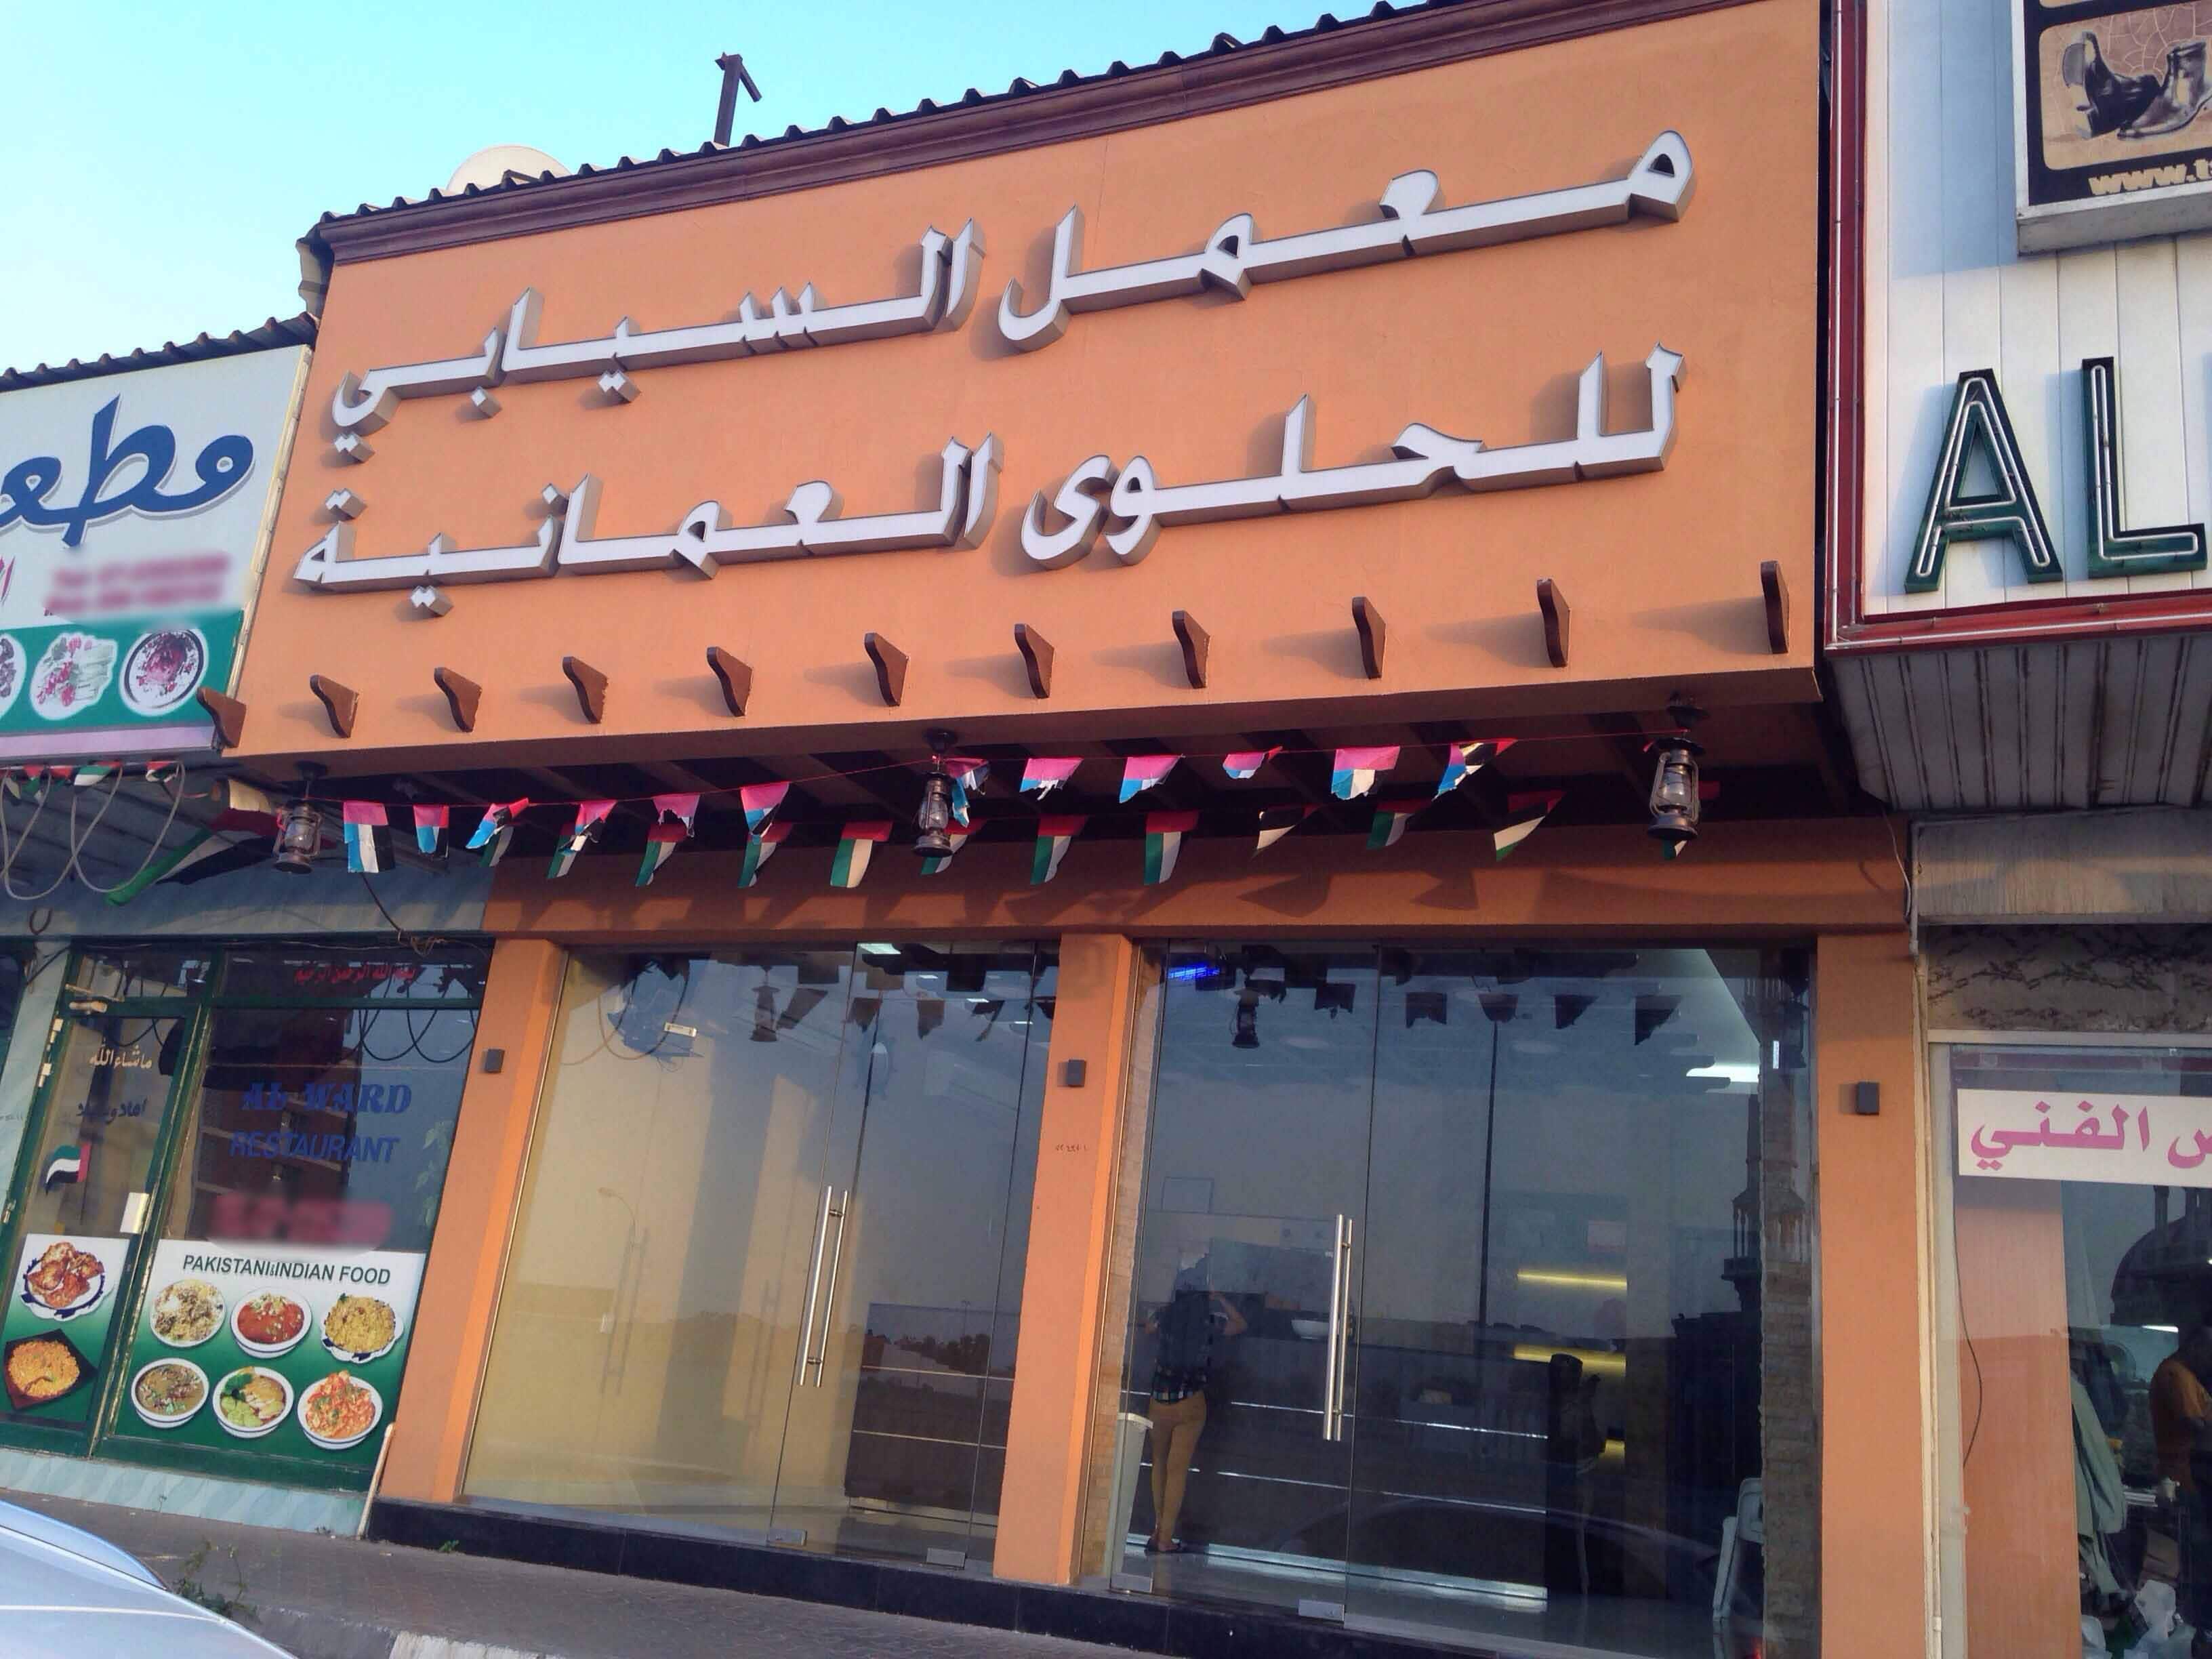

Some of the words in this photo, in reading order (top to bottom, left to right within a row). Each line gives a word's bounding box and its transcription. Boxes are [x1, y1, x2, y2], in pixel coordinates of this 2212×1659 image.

[998, 131, 1694, 352] معمل
[332, 219, 983, 464] السيابي
[1021, 343, 1685, 569] للحلوى
[293, 432, 1003, 617] العمانية
[230, 1130, 401, 1163] RESTAURANT
[304, 1082, 412, 1113] WARD
[1971, 1100, 2150, 1170] الفني
[338, 1265, 392, 1285] FOOD
